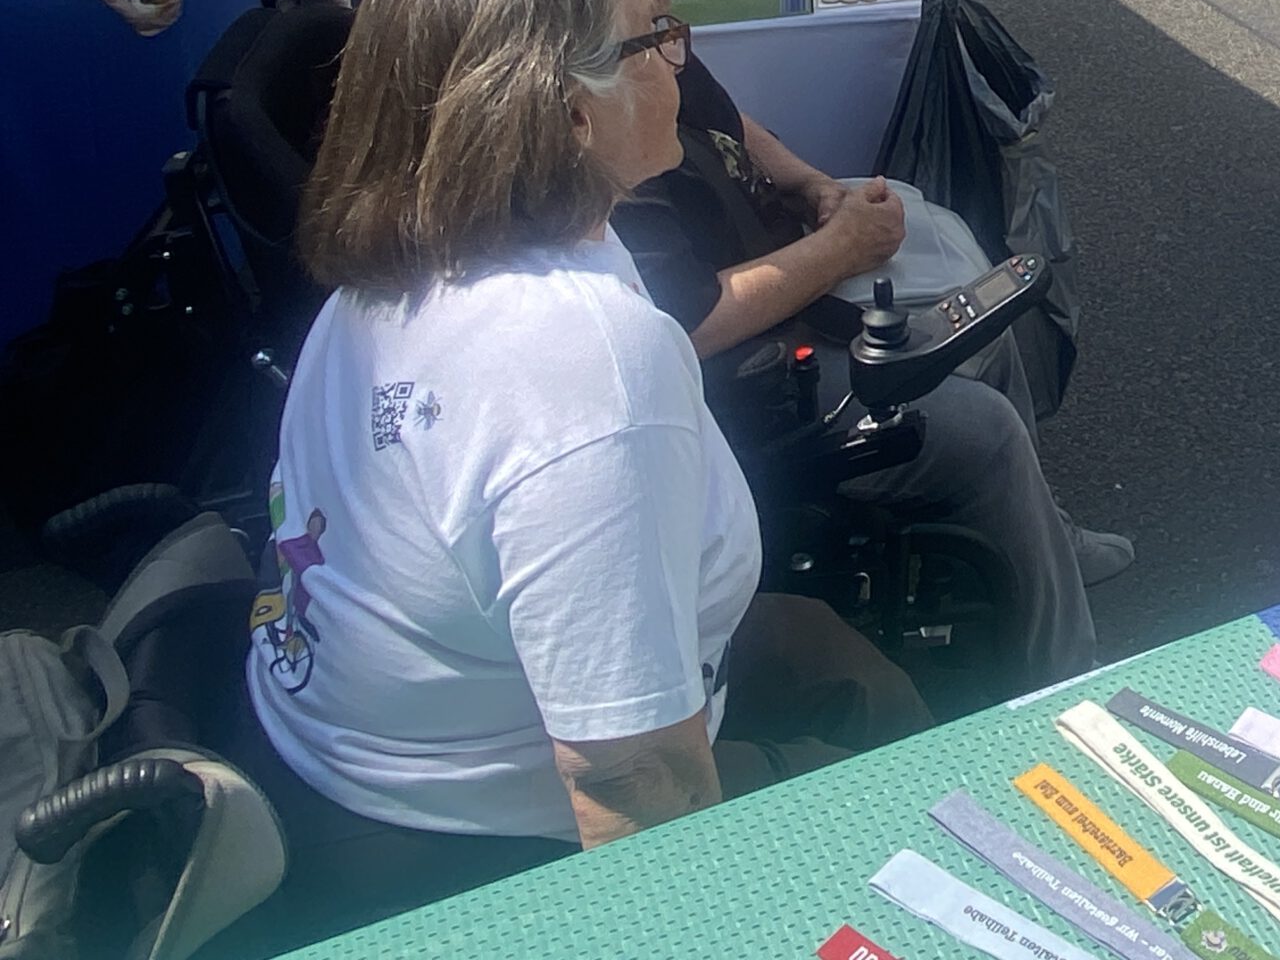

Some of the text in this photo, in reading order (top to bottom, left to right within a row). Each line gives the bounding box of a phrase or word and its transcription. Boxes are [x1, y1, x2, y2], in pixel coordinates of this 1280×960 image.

[1139, 704, 1247, 764] Lebenshilfe Momente
[1112, 743, 1163, 788] Stärke
[1033, 779, 1059, 800] Ziel
[1197, 770, 1243, 802] Hanau
[1238, 795, 1271, 816] sind
[1157, 785, 1211, 834] unsere
[1071, 812, 1133, 868] Barrierefrei
[1203, 831, 1232, 854] ist
[1012, 851, 1063, 891] Teilhabe
[963, 905, 1018, 943] Teilhabe
[1061, 887, 1120, 928] gestalten
[1115, 924, 1140, 943] Wir
